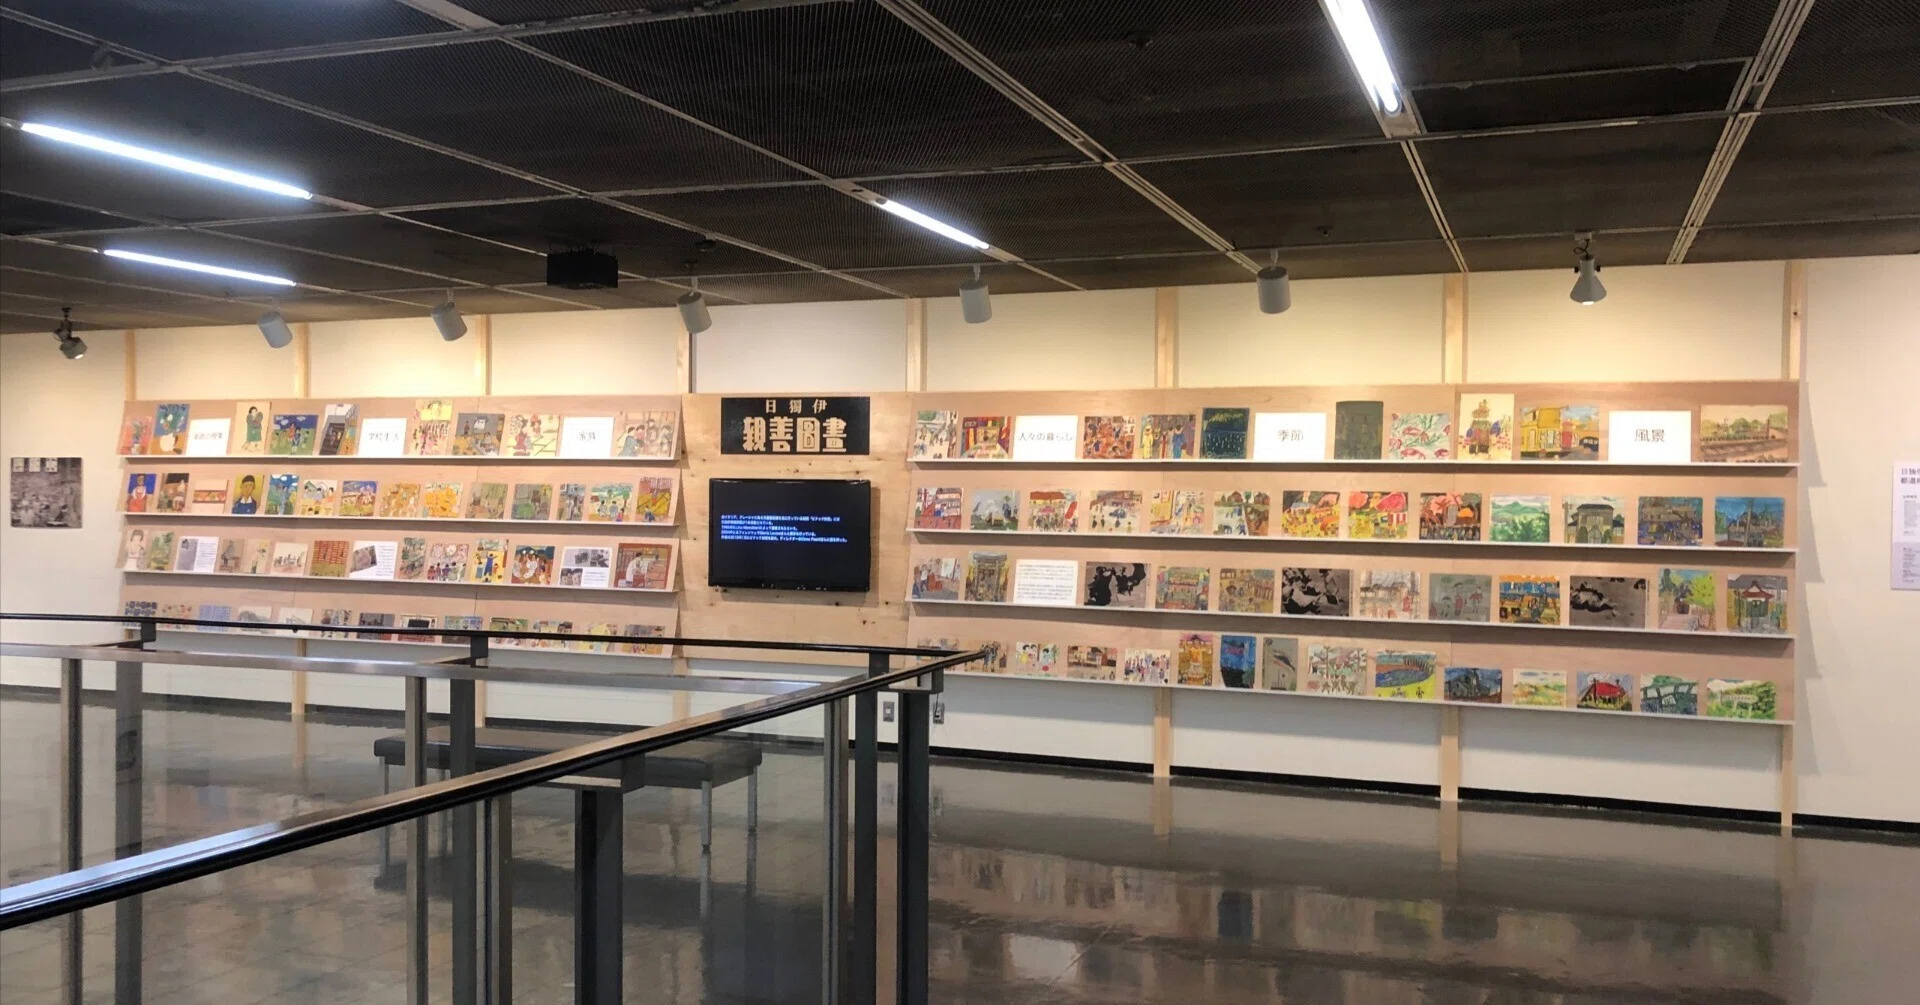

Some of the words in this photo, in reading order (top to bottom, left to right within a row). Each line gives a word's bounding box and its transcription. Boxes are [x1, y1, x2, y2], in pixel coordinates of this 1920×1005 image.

[1018, 432, 1073, 441] 人々の暮らし
[1277, 429, 1304, 442] 季節
[1634, 428, 1665, 442] 風景
